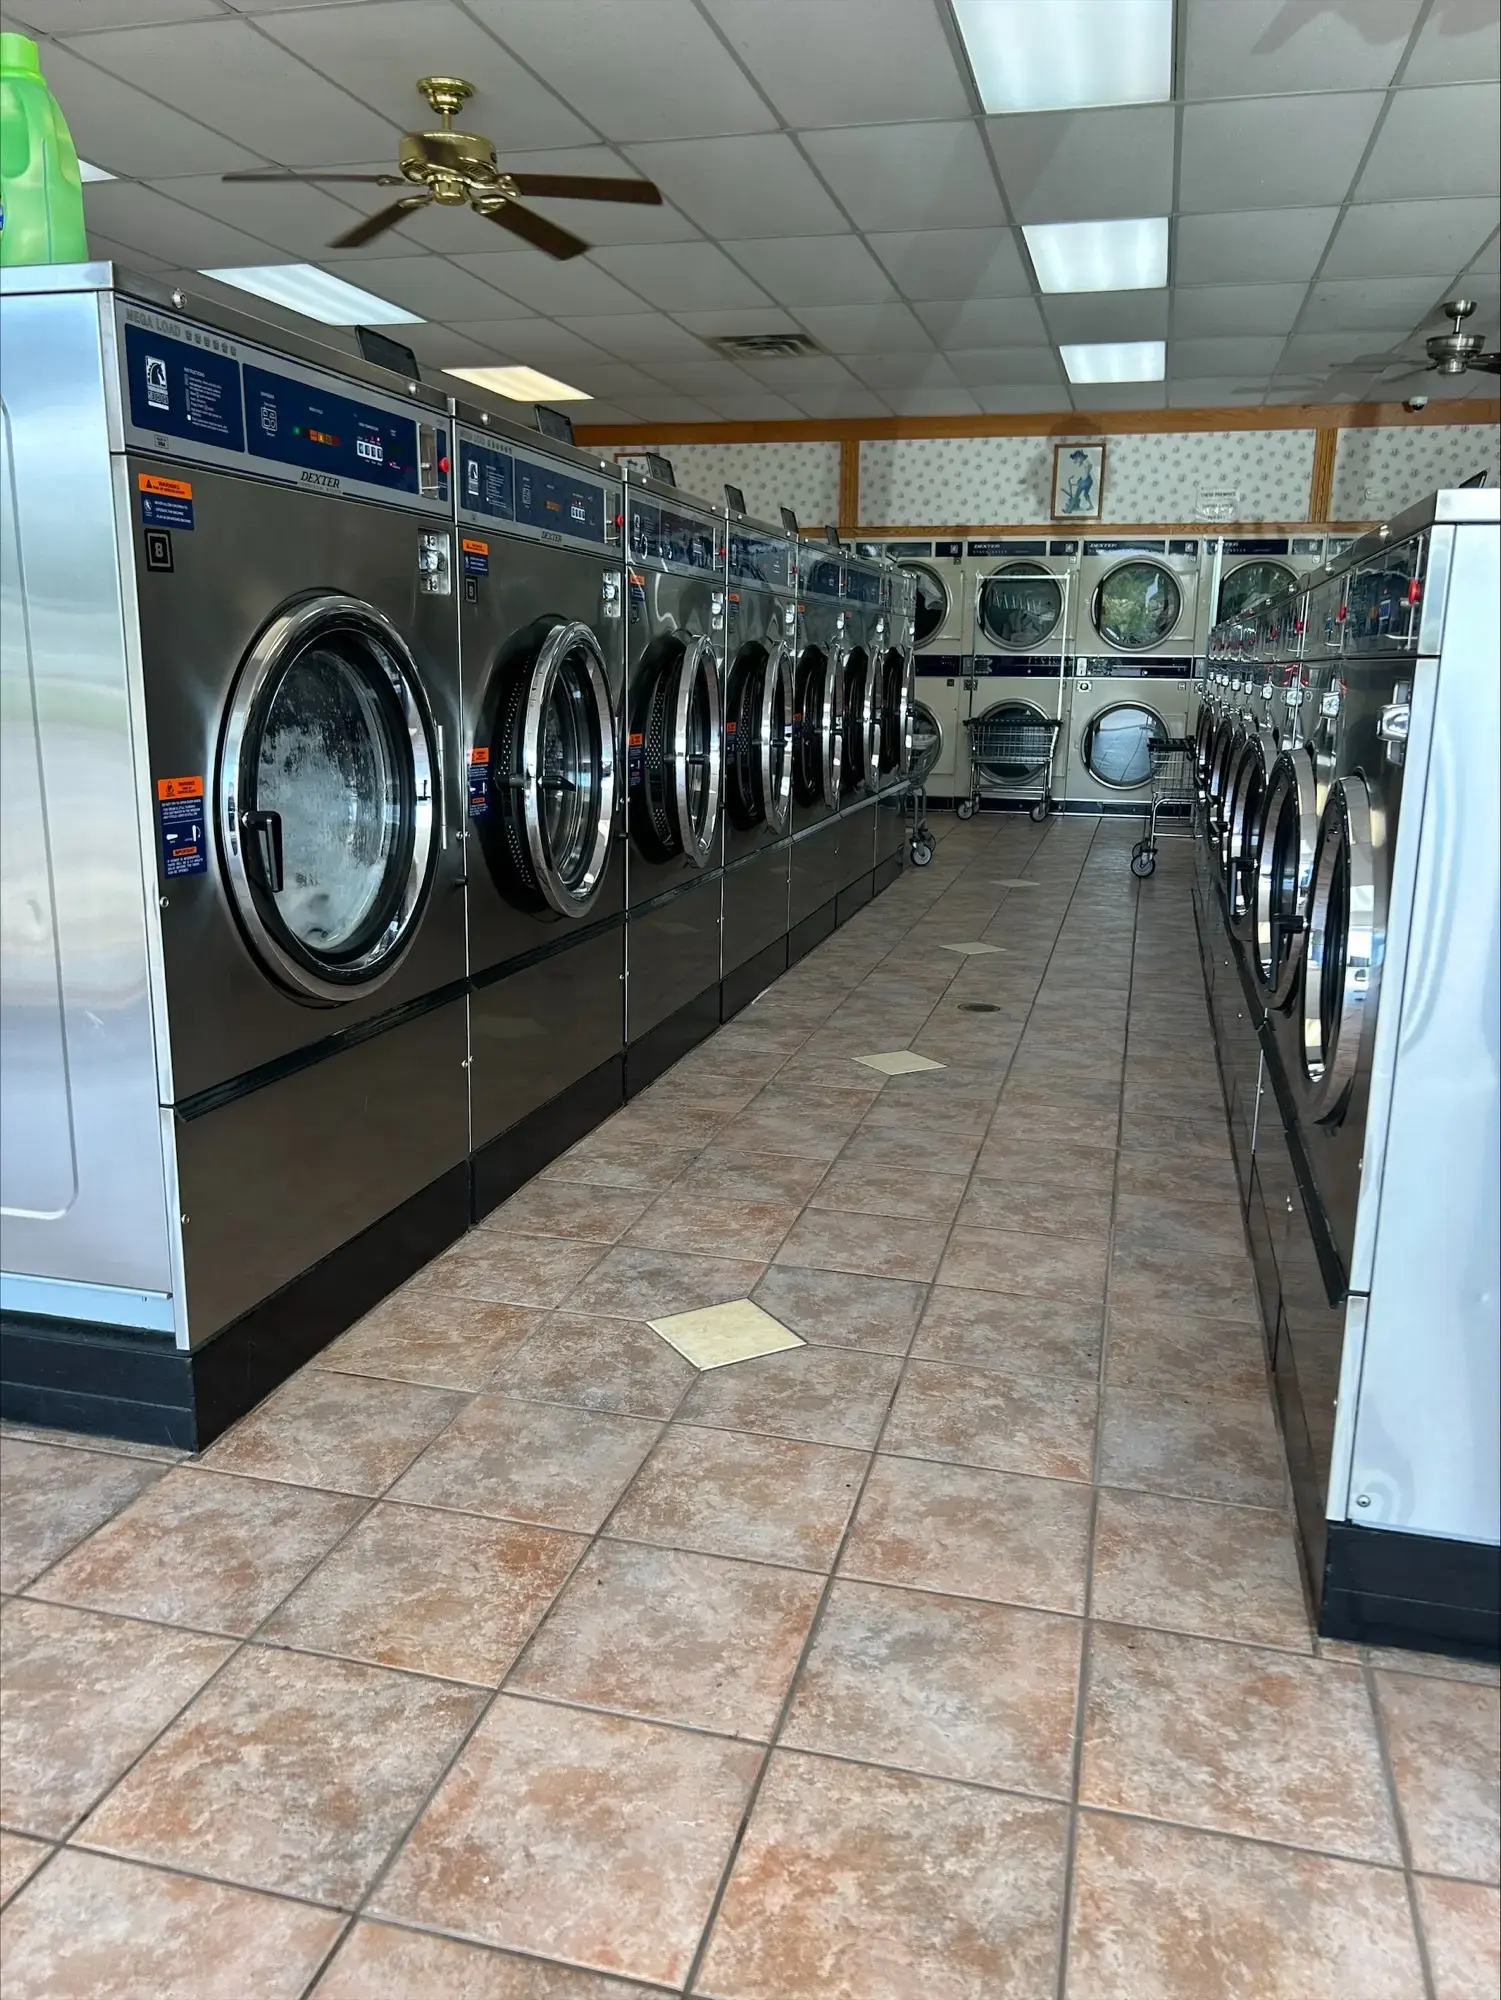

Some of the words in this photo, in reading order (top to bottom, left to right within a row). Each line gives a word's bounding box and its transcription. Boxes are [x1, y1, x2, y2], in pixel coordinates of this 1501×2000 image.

[126, 308, 154, 329] MEGA
[155, 318, 181, 338] LOAD
[300, 470, 341, 488] DEXTER
[541, 531, 562, 542] DEXTER
[155, 542, 163, 557] 8
[174, 847, 195, 856] IMPORTANT
